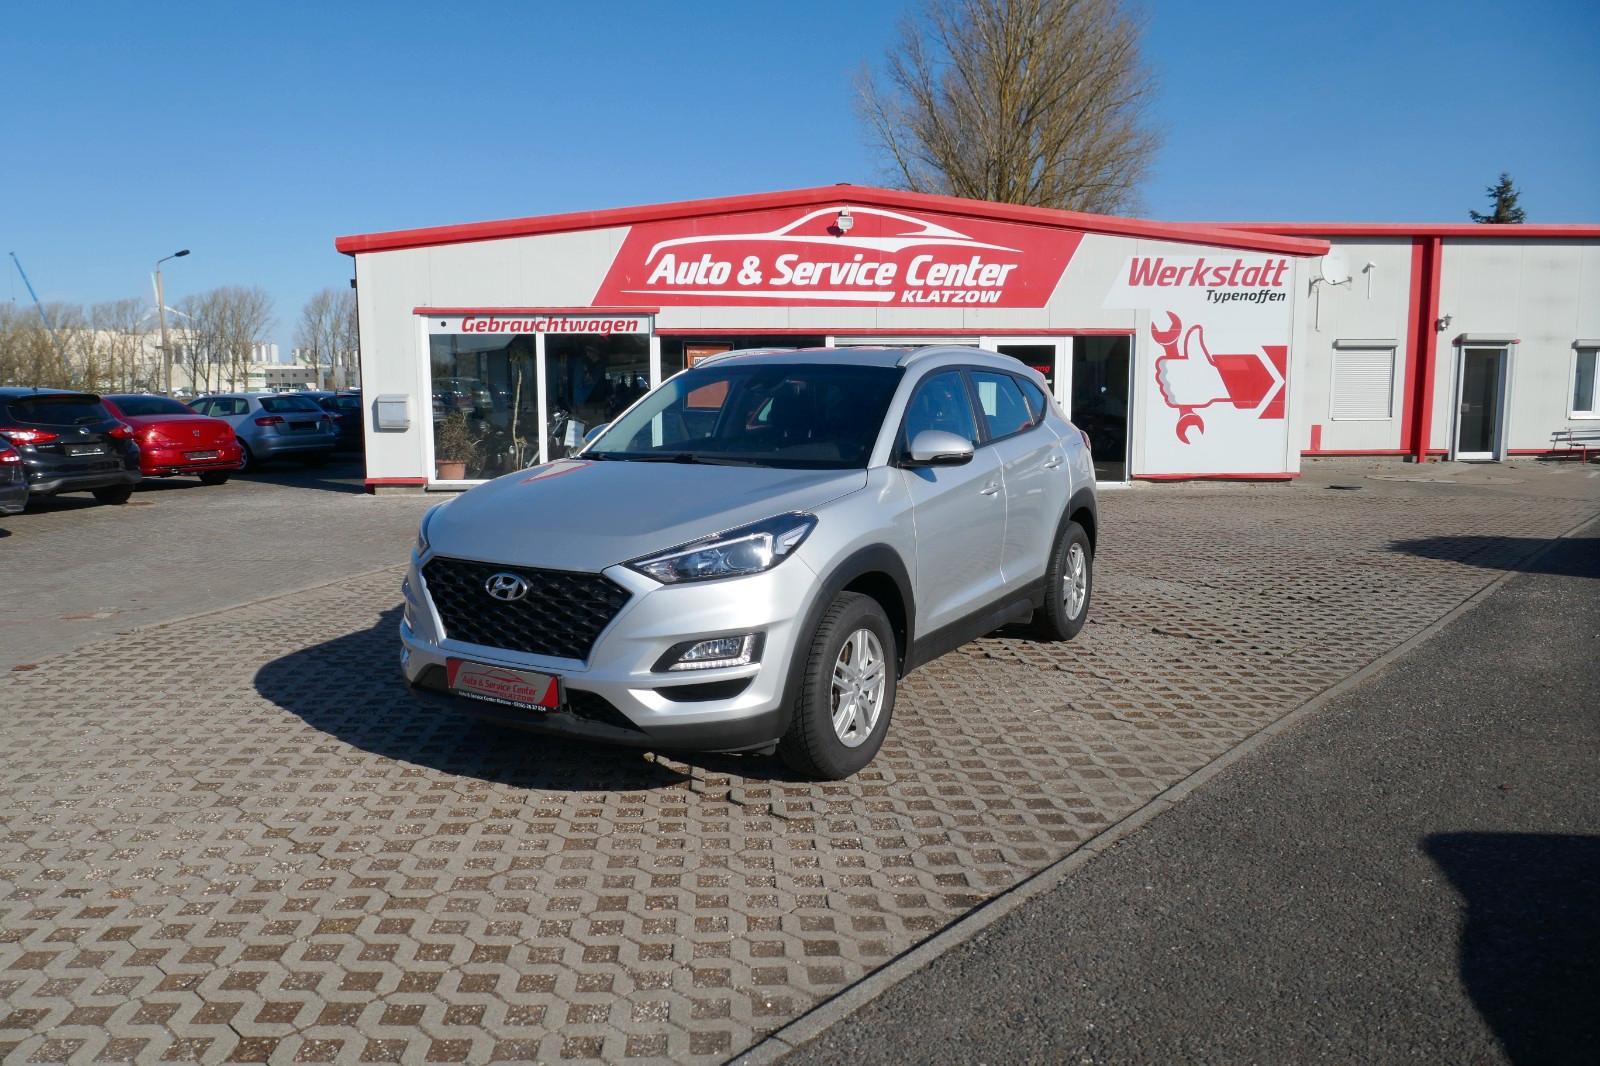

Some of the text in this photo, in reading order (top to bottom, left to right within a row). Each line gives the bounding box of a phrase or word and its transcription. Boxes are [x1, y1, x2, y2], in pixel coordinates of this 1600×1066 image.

[647, 254, 1017, 287] Auto & Service Center
[1128, 257, 1289, 287] Werkstatt
[901, 290, 1003, 303] KLATZOW
[1206, 289, 1286, 304] Typenoffen
[461, 316, 638, 337] Gebrauchtwagen
